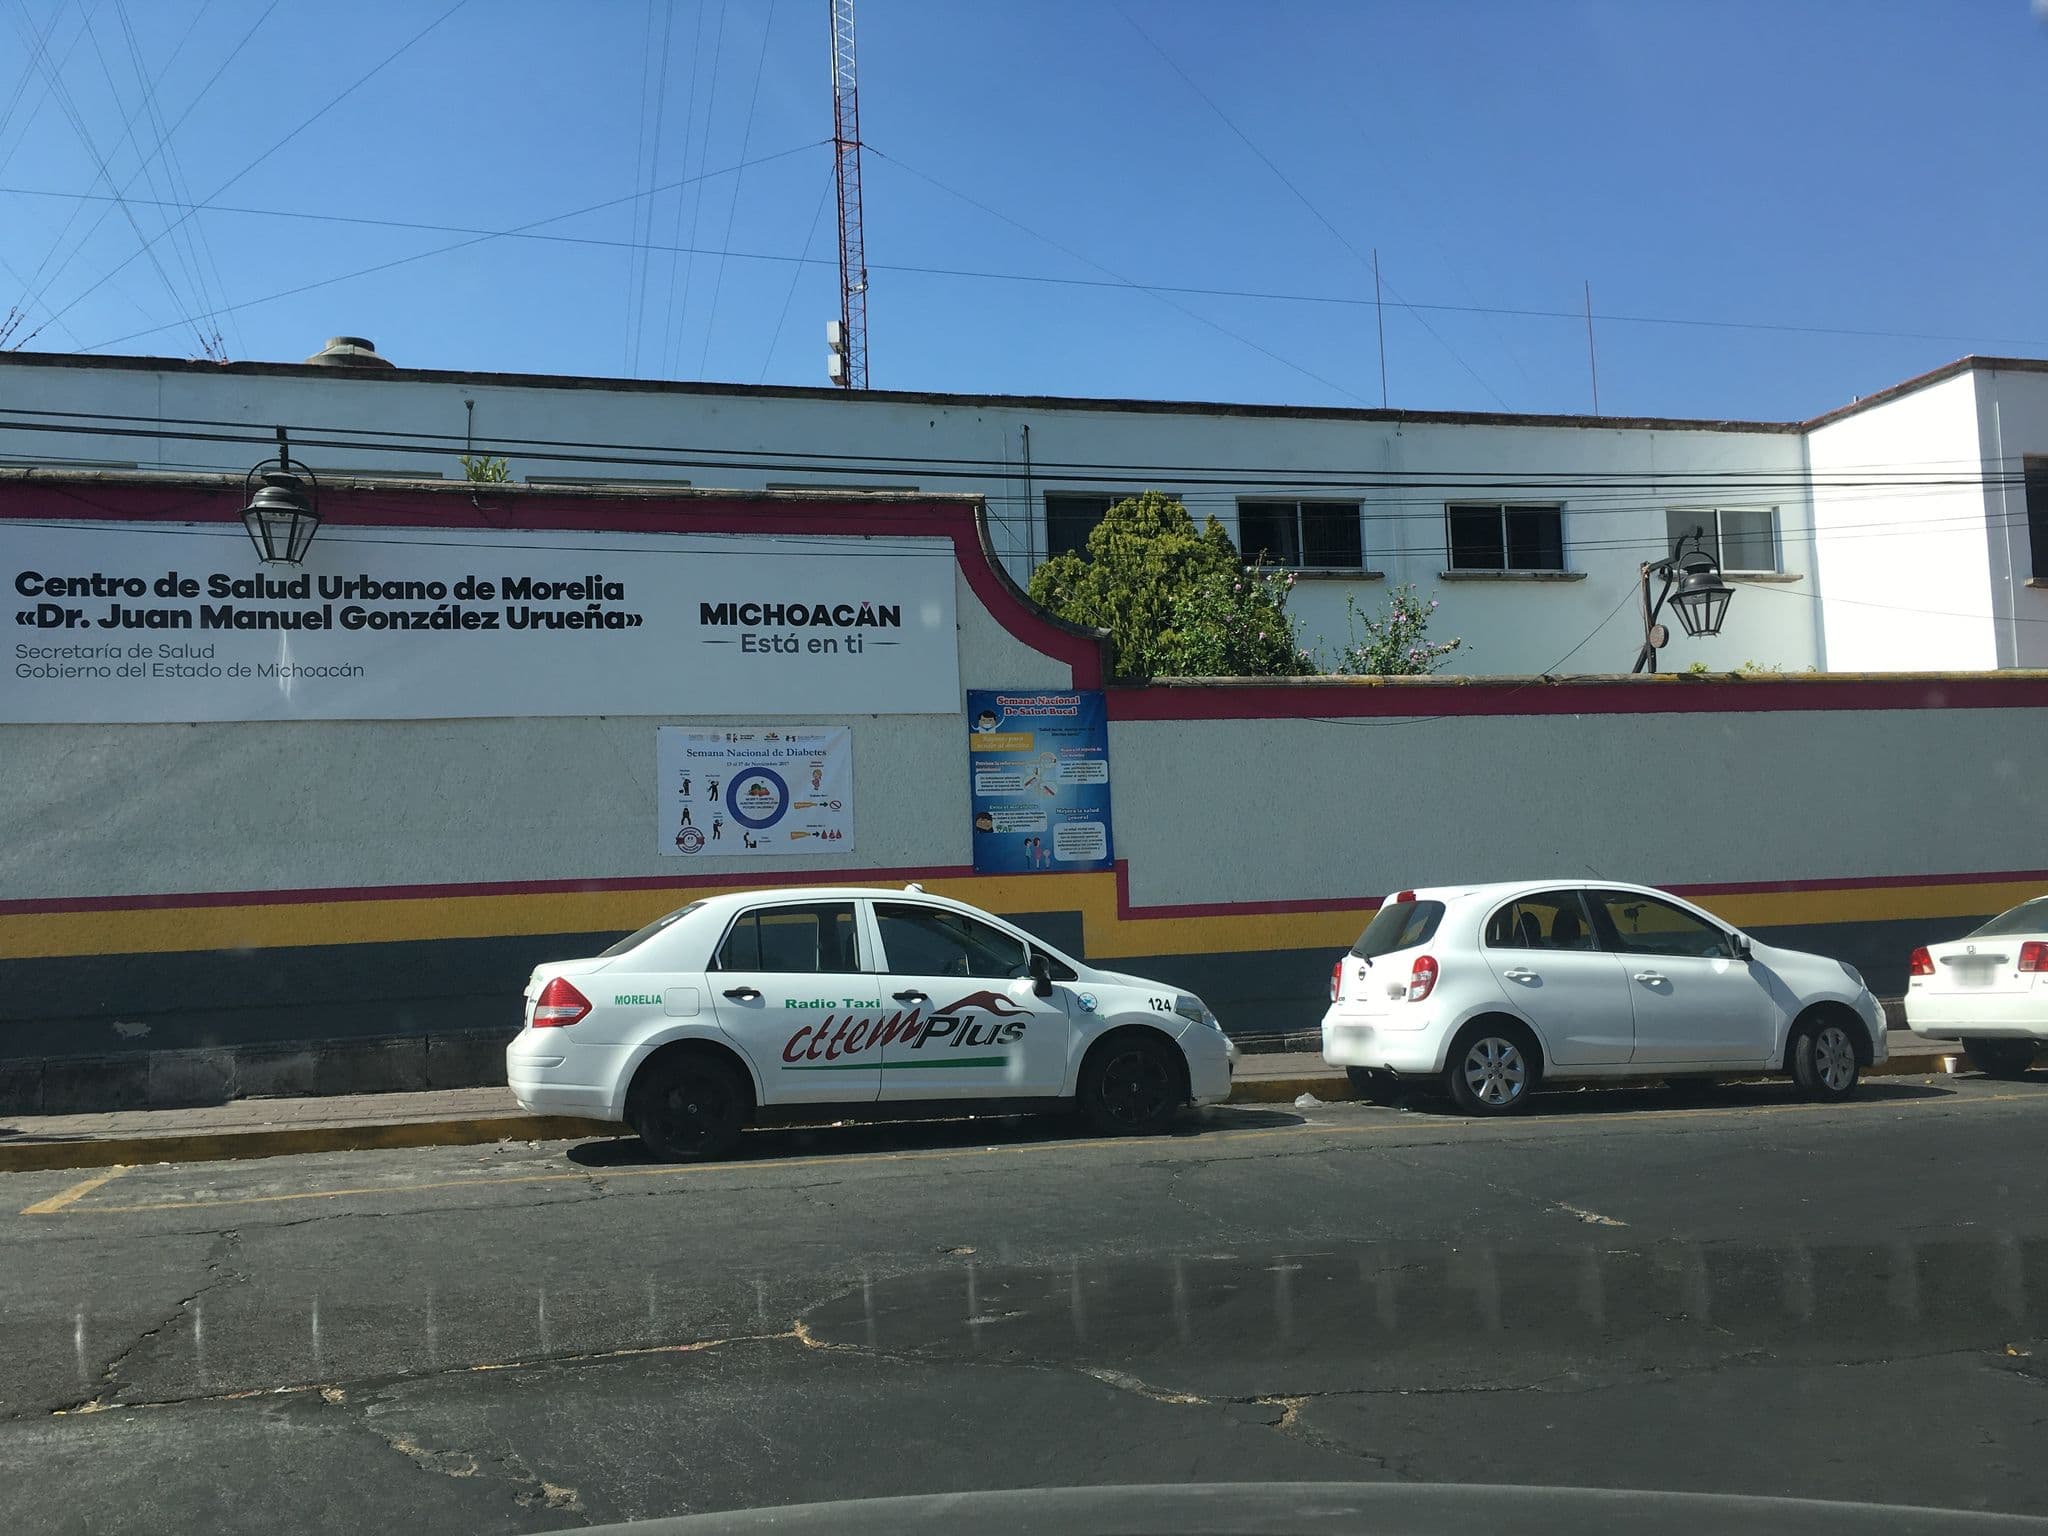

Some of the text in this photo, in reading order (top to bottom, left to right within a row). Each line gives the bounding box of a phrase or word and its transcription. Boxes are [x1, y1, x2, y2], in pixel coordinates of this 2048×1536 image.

[15, 571, 625, 601] Centro de Salud Urbano de Morelia
[97, 604, 193, 630] Juan
[200, 604, 333, 631] Manuel
[340, 602, 500, 631] González
[15, 642, 215, 660] Secretaría de Salud
[741, 632, 863, 655] Está en ti
[15, 662, 365, 679] Gobierno del Estado de Michoacán
[997, 695, 1080, 705] Semana Nacional
[1019, 707, 1047, 716] Salud
[1048, 707, 1077, 716] Bucal
[686, 747, 827, 758] Semana Nacional de Diabetes
[614, 994, 666, 1009] MORELIA
[784, 998, 881, 1010] Radio Taxi
[1148, 998, 1175, 1014] 124
[910, 1015, 1026, 1049] Plus
